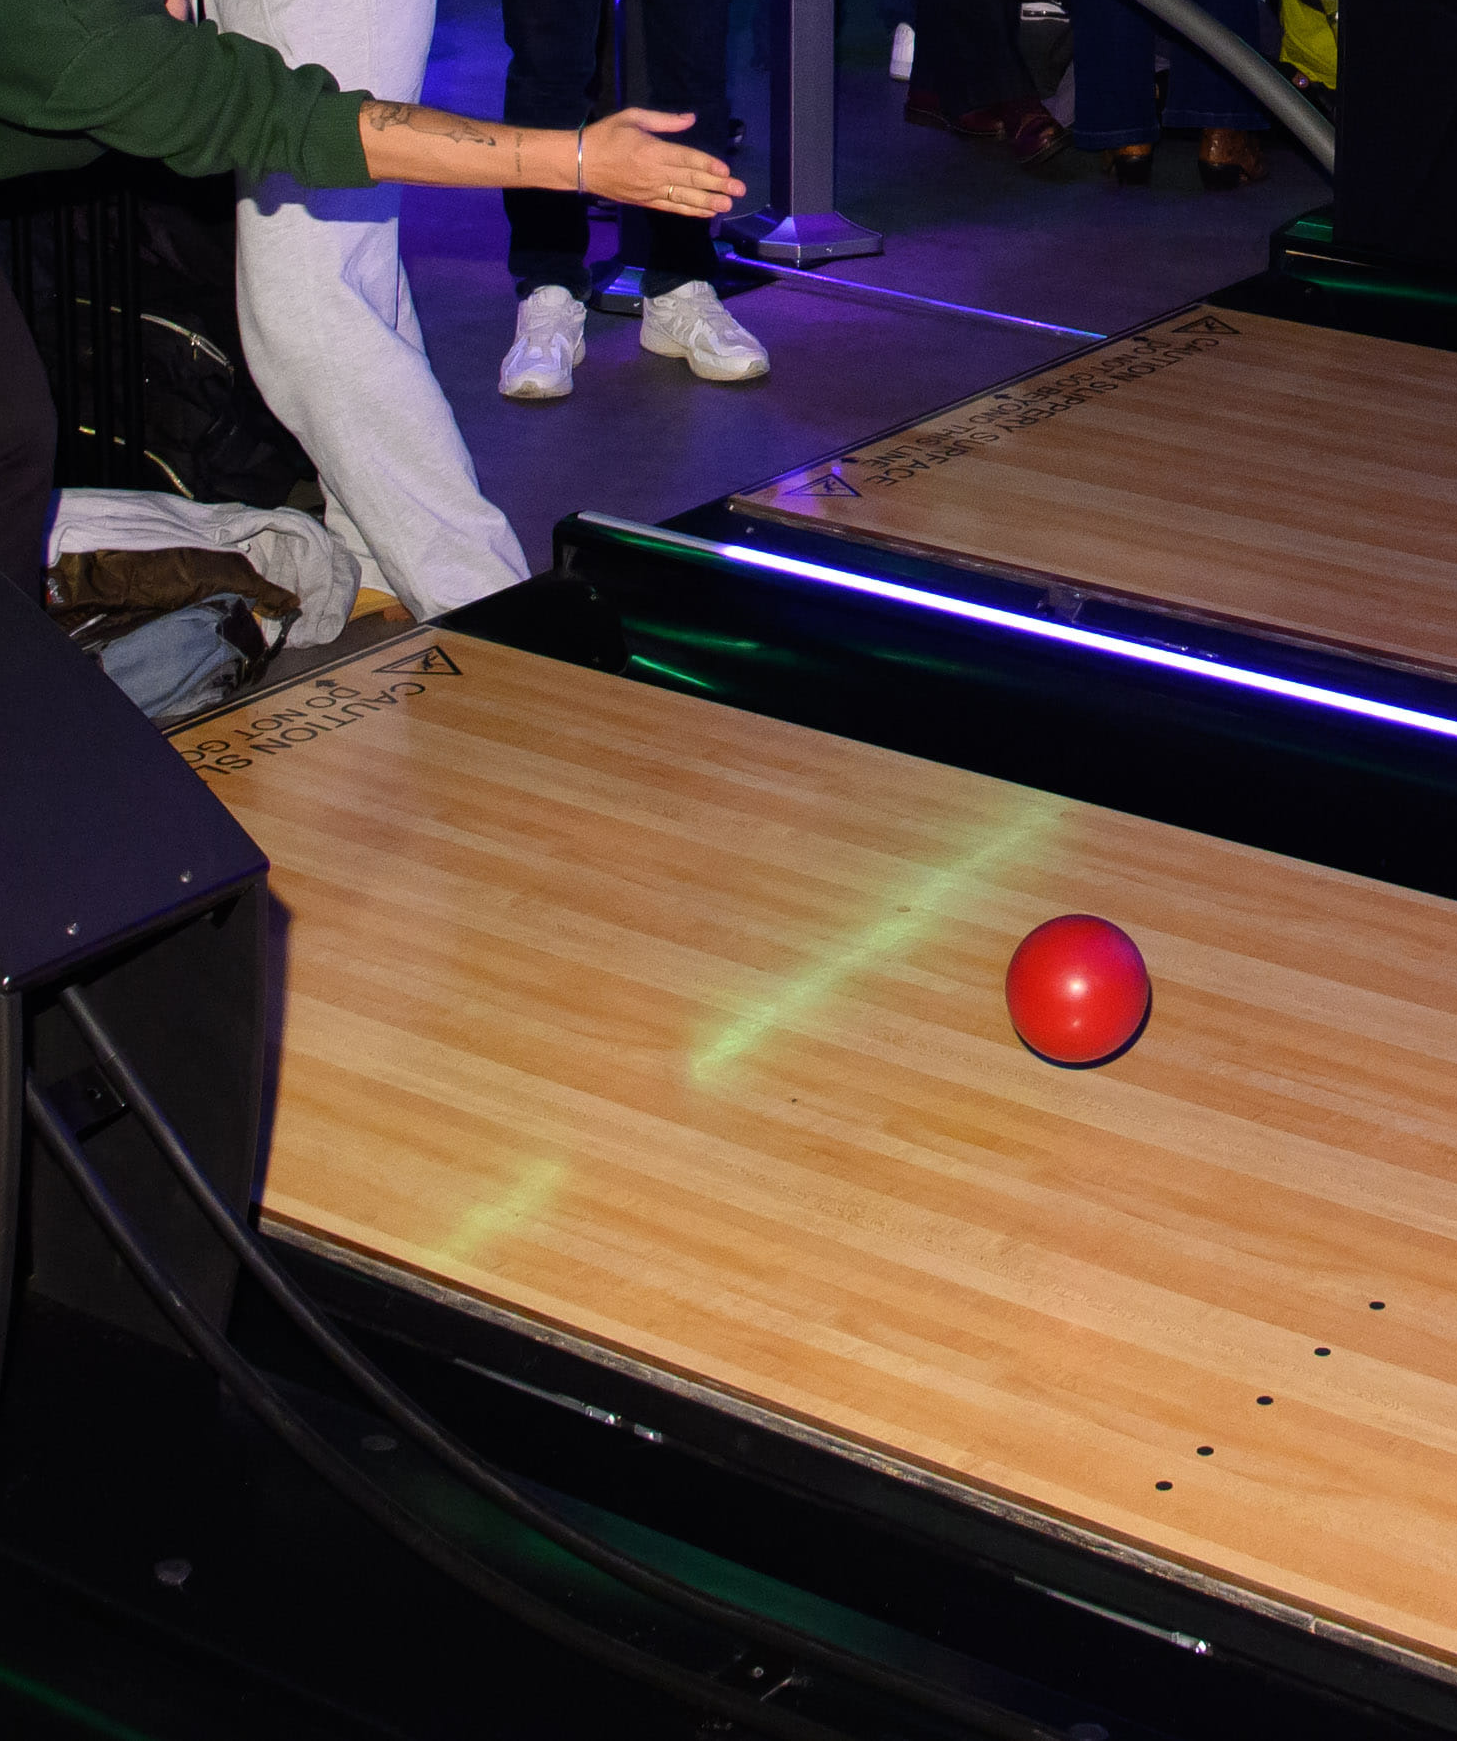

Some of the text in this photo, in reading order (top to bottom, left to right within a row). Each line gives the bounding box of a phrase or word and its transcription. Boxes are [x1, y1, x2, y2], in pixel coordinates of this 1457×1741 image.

[862, 340, 1170, 469] DO NOT GO BEYOND THIS LINE
[863, 337, 1219, 487] CAUTION SLIPPERY SURFACE
[234, 708, 306, 741] NOT
[250, 682, 426, 755] CAUTION
[305, 686, 360, 709] DO
